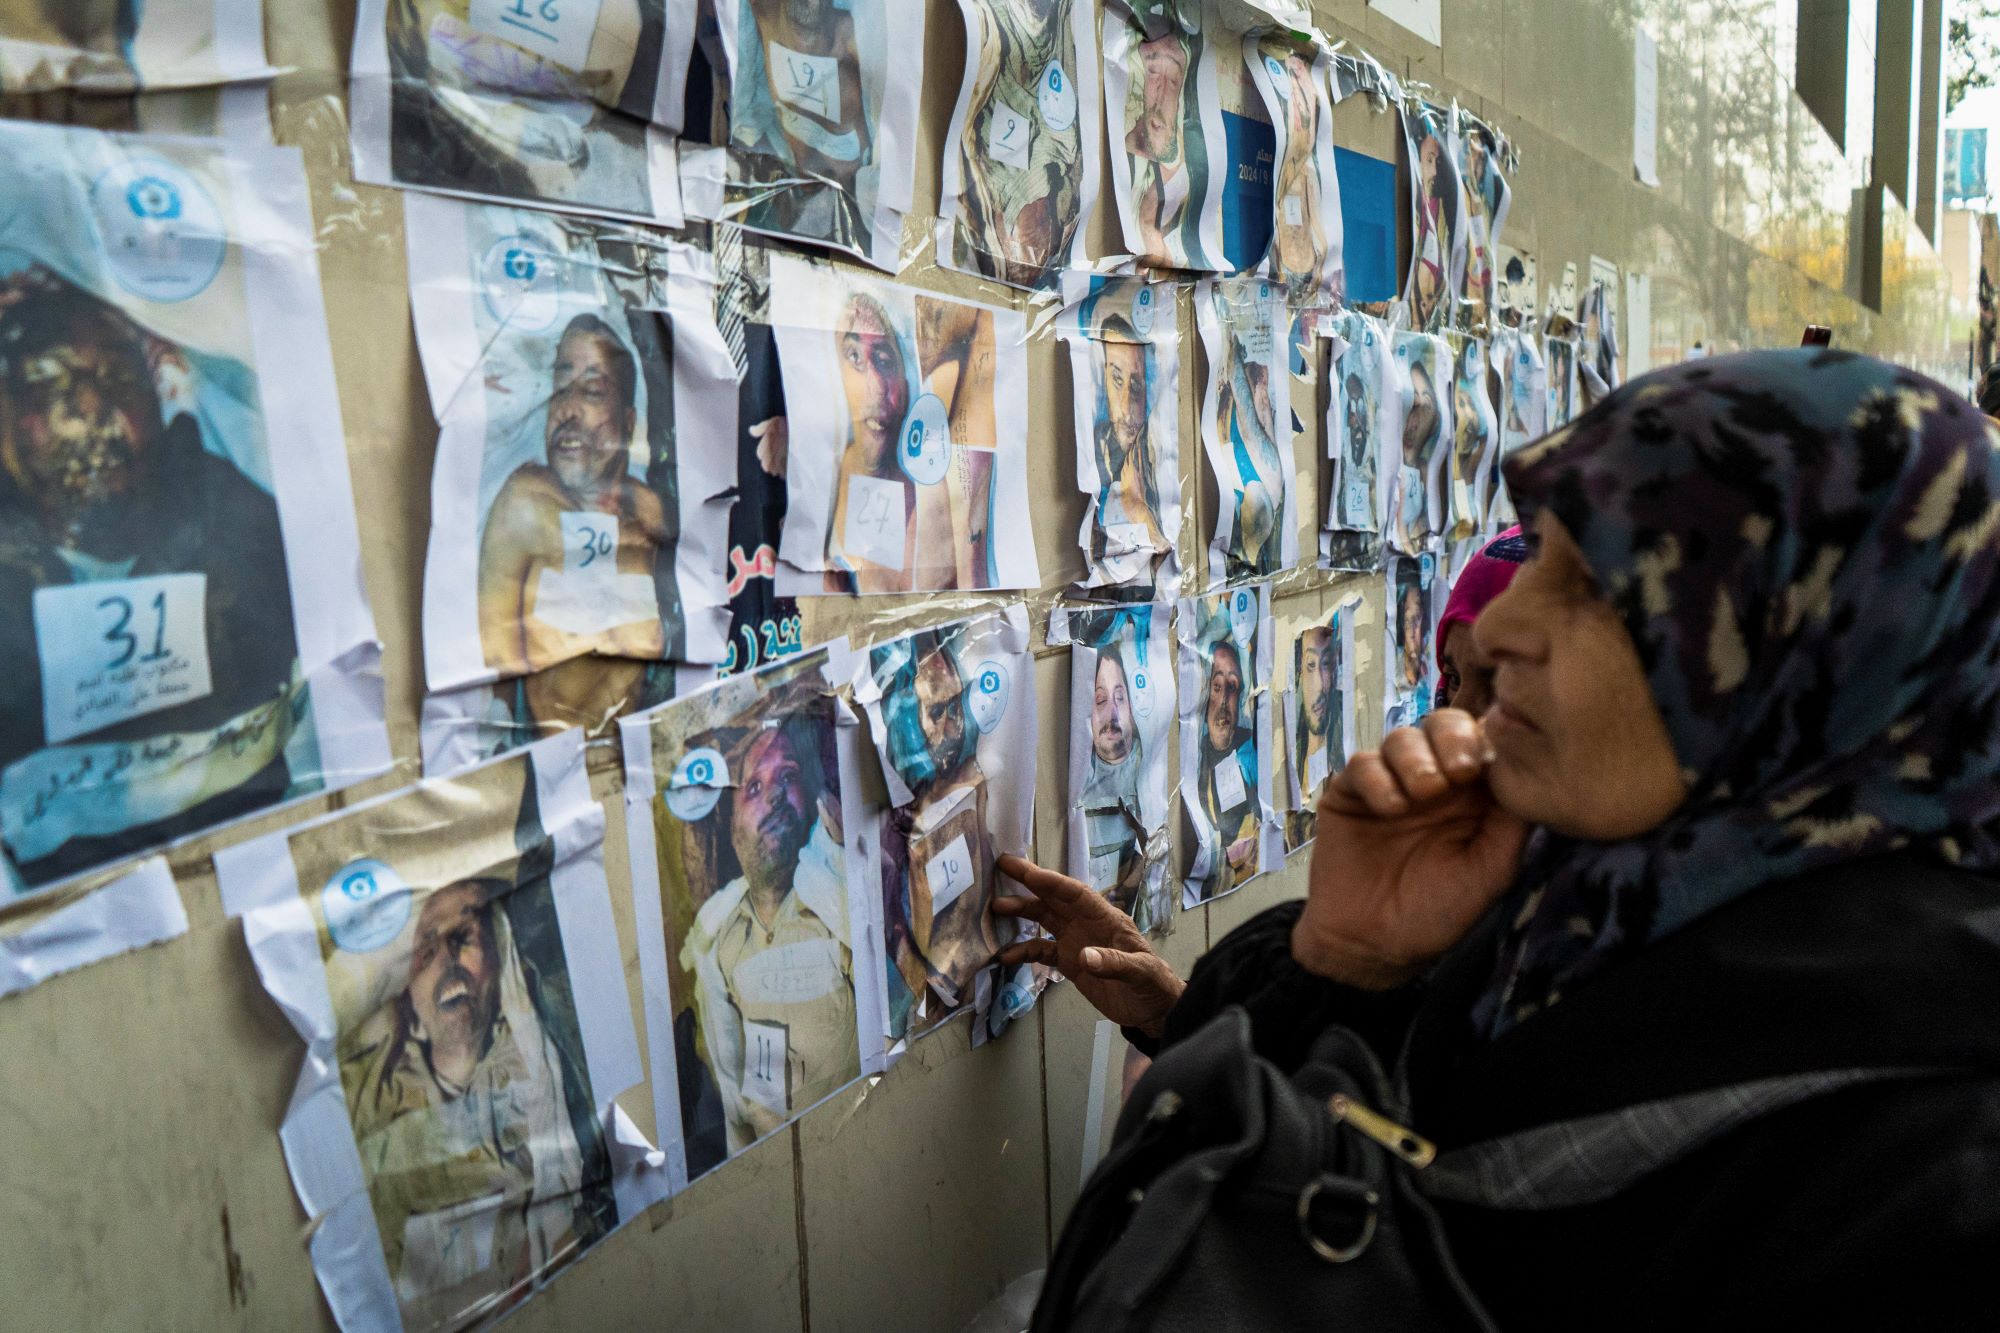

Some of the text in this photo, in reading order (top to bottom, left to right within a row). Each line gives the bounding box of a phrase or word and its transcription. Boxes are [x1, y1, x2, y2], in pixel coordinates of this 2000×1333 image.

[786, 55, 815, 89] 19
[1002, 119, 1015, 141] 9
[1238, 163, 1258, 183] 2024
[856, 486, 891, 534] 27
[576, 525, 613, 569] 30
[95, 590, 172, 670] 31
[942, 859, 959, 890] 10
[756, 1034, 772, 1083] 11
